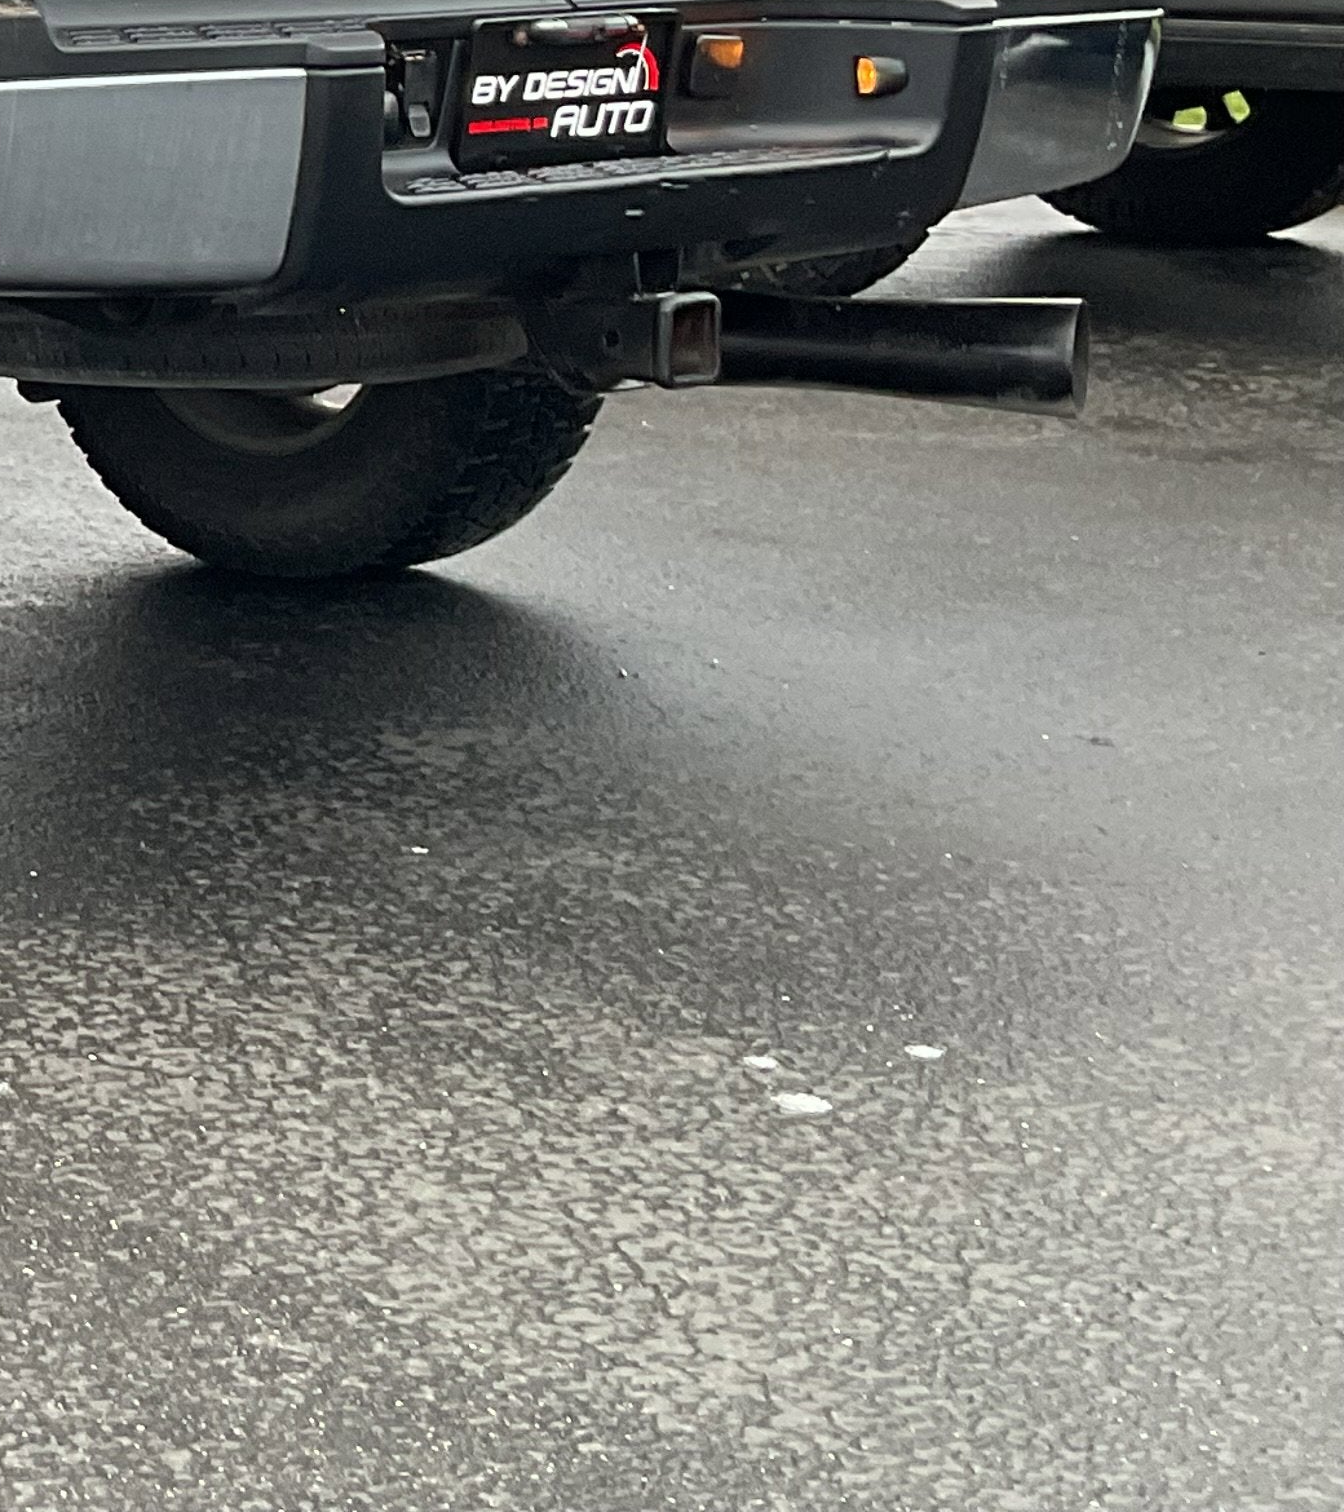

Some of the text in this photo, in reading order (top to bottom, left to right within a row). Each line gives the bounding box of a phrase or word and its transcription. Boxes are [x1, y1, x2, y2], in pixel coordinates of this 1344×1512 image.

[471, 66, 637, 105] BY DESIGN
[550, 99, 656, 138] AUTO
